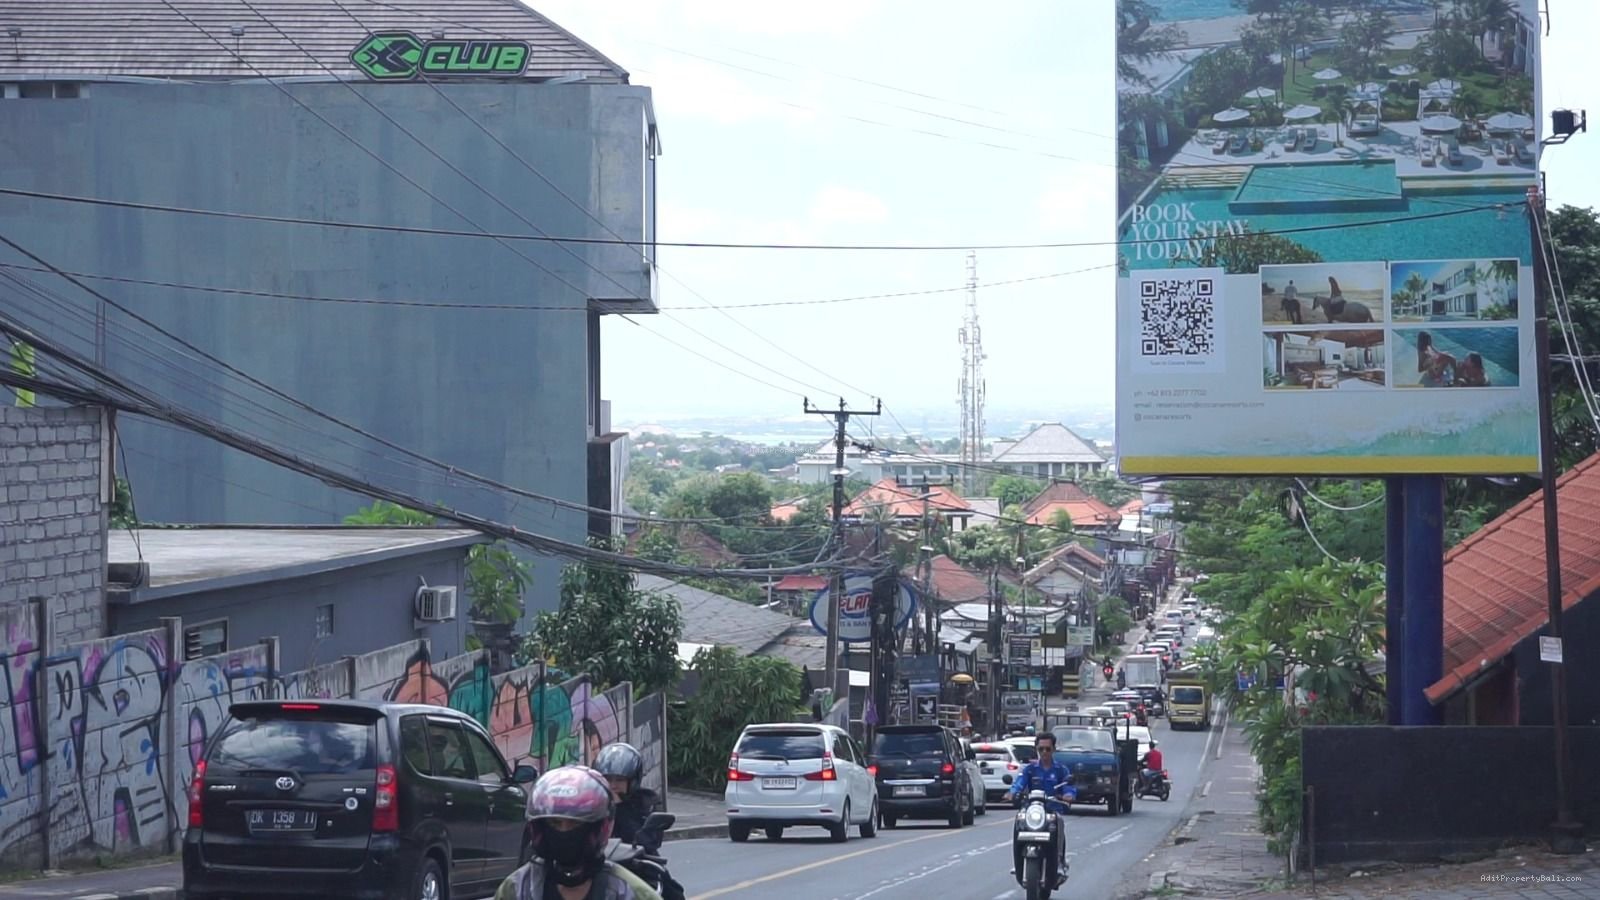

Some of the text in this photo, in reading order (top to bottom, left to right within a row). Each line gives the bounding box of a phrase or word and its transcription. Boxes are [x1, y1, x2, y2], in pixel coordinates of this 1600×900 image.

[423, 46, 525, 71] CLUB
[1131, 202, 1196, 222] BOOK
[1131, 219, 1249, 241] YOUR STAY
[251, 810, 263, 823] DK
[273, 811, 295, 824] 1358
